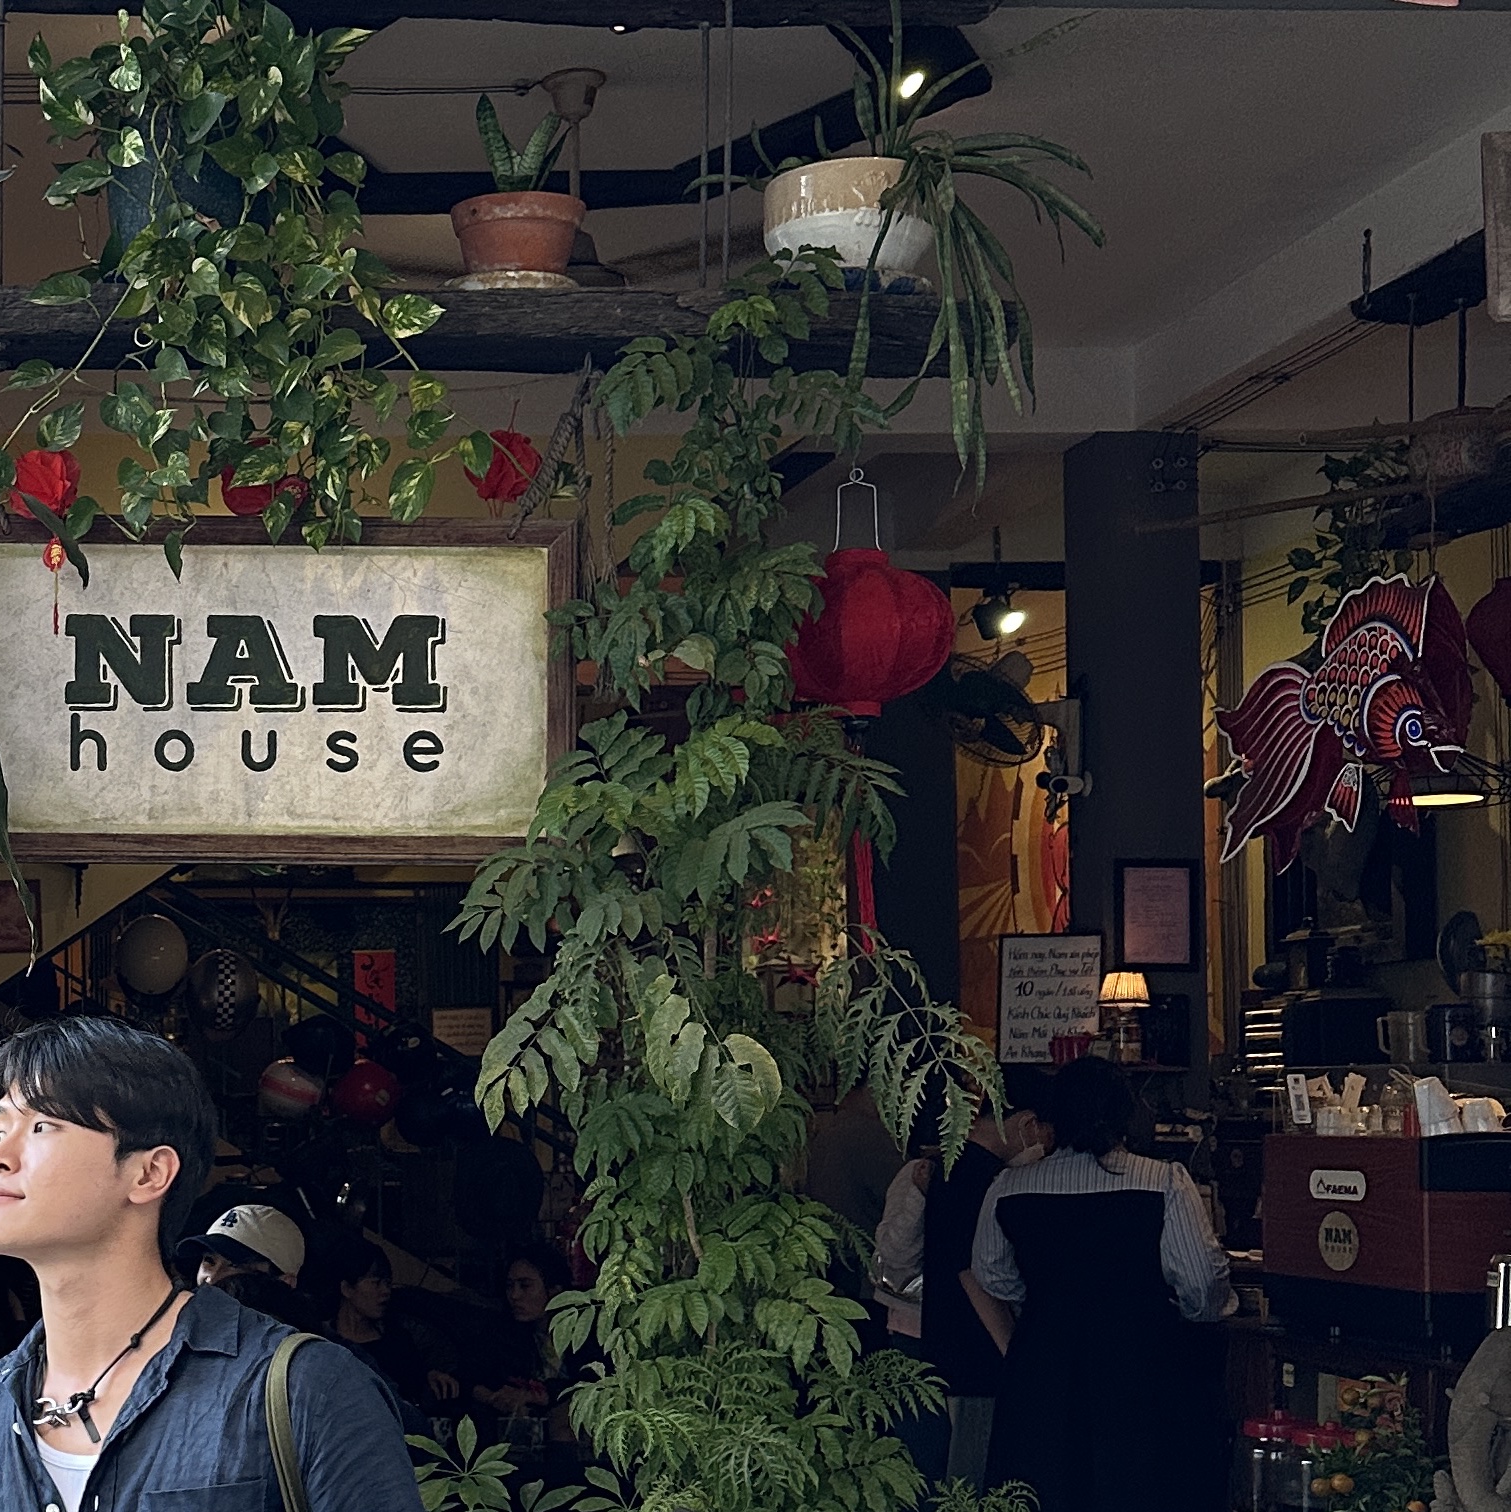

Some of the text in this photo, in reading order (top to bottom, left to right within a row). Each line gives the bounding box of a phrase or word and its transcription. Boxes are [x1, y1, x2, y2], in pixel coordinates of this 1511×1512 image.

[64, 614, 446, 713] NAM
[69, 714, 444, 773] house
[1015, 980, 1034, 997] 10
[1325, 1184, 1358, 1195] FAEMA
[1324, 1227, 1352, 1245] NAM
